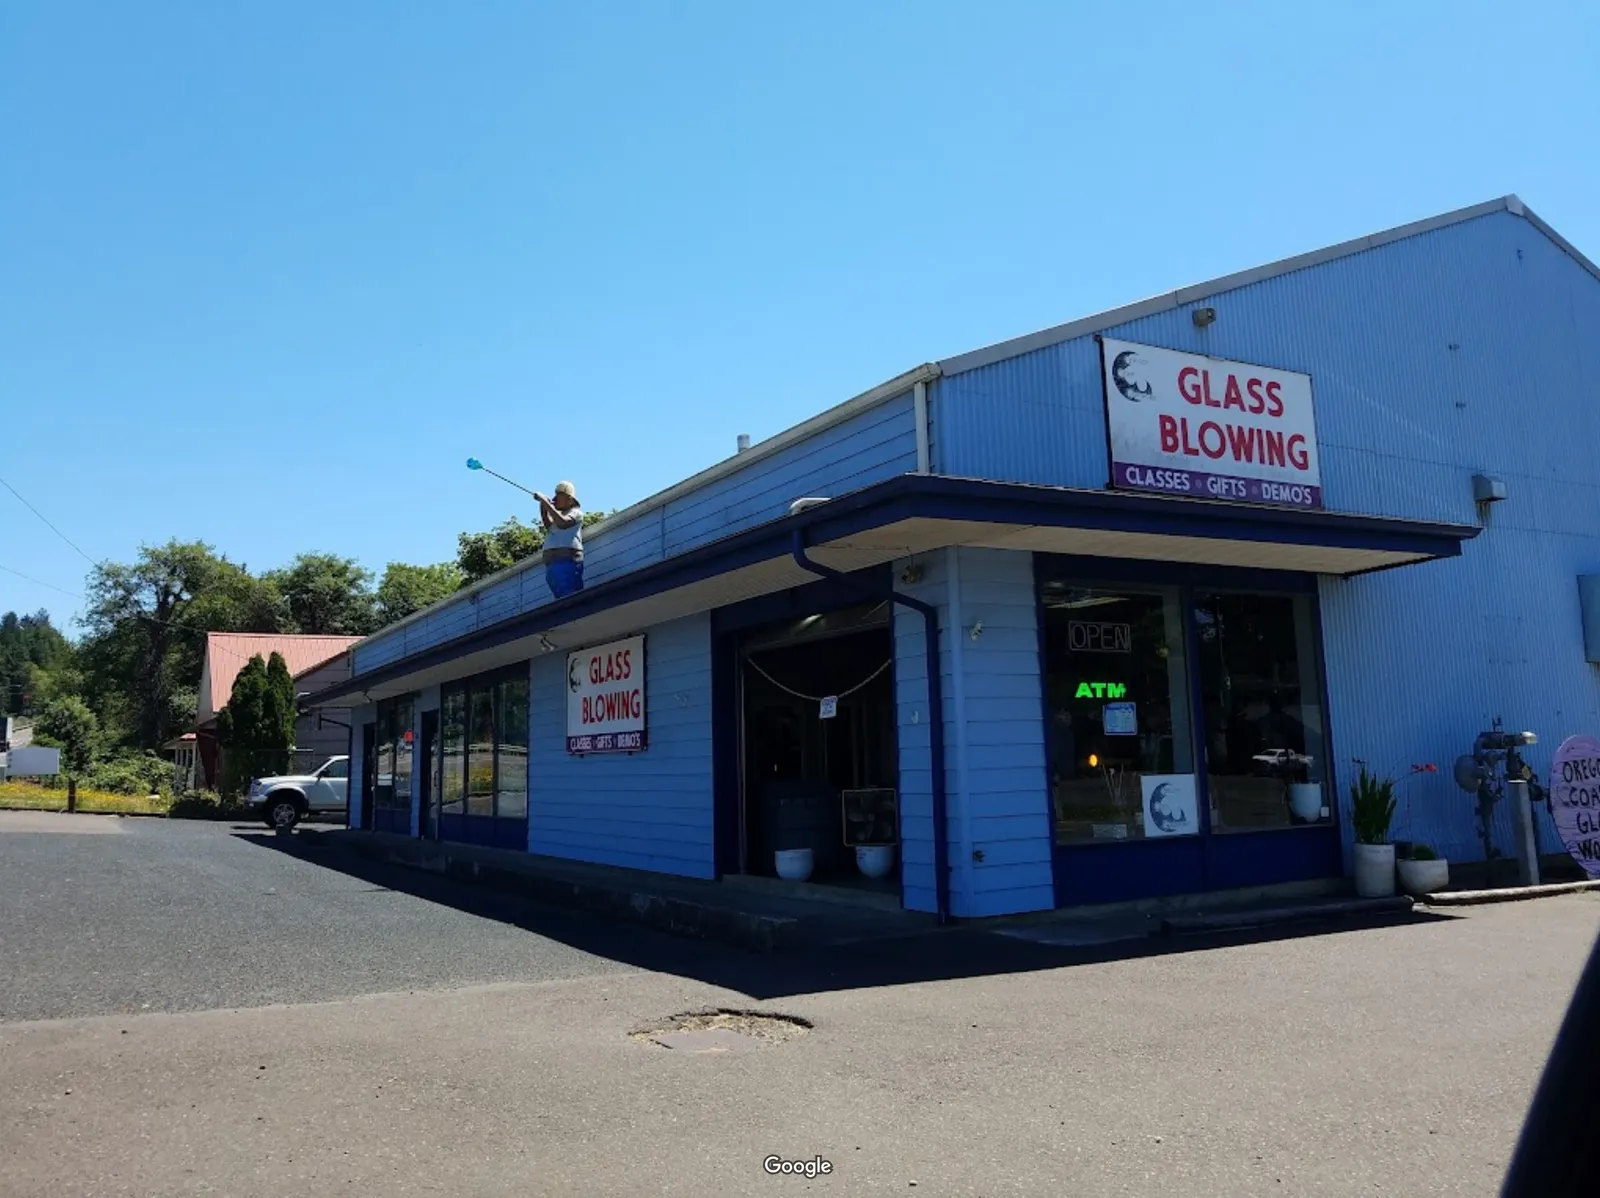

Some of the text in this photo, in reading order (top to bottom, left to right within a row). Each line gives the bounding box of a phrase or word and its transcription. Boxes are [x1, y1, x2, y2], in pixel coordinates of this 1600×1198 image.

[1177, 366, 1284, 418] GLASS
[1158, 413, 1310, 471] BLOWING
[1125, 466, 1313, 505] CLASSES GIFTS DEMO'S
[1072, 624, 1129, 650] OPEN
[589, 649, 632, 685] GLASS
[1074, 682, 1127, 699] ATM
[581, 688, 641, 725] BLOWING
[596, 735, 613, 749] GIFTS
[1569, 784, 1600, 807] COA
[1576, 811, 1600, 835] GL
